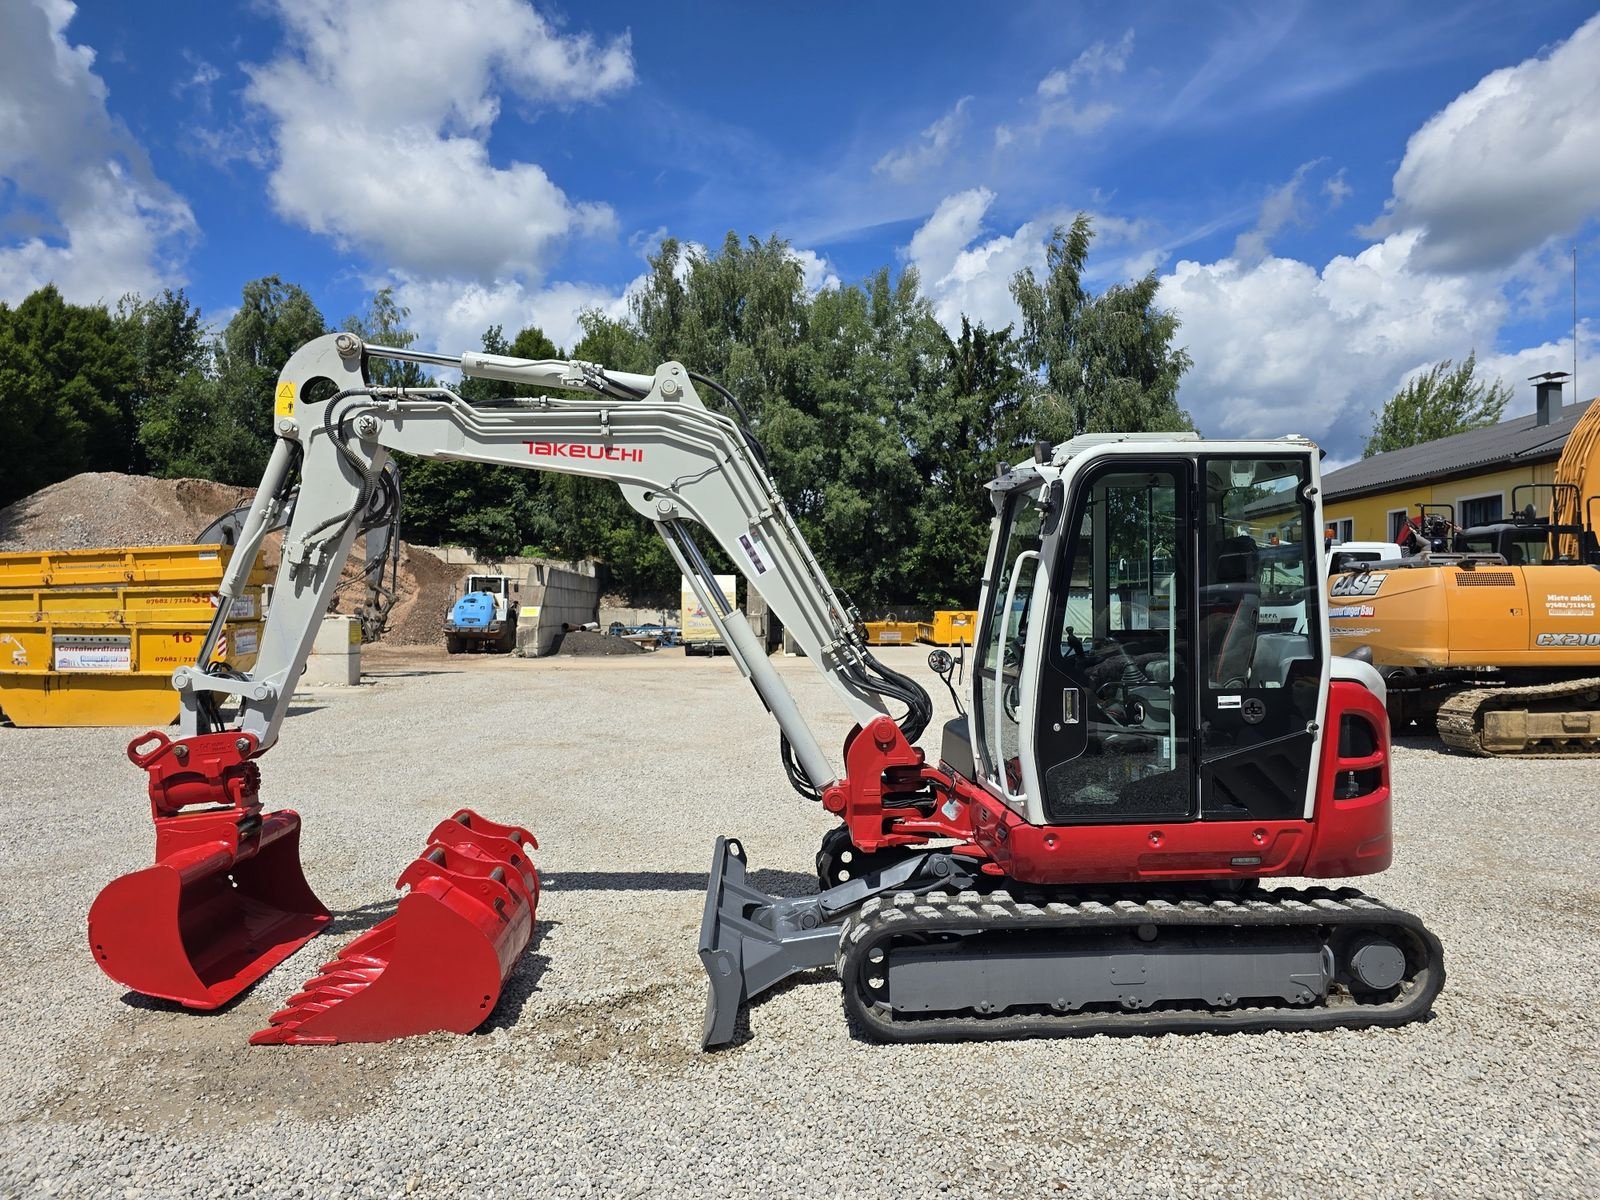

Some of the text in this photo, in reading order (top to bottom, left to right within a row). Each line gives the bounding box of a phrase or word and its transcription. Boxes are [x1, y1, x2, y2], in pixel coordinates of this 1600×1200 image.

[1331, 573, 1388, 597] CASE
[192, 592, 211, 604] 35
[172, 632, 193, 644] 16
[1536, 633, 1600, 646] CX210
